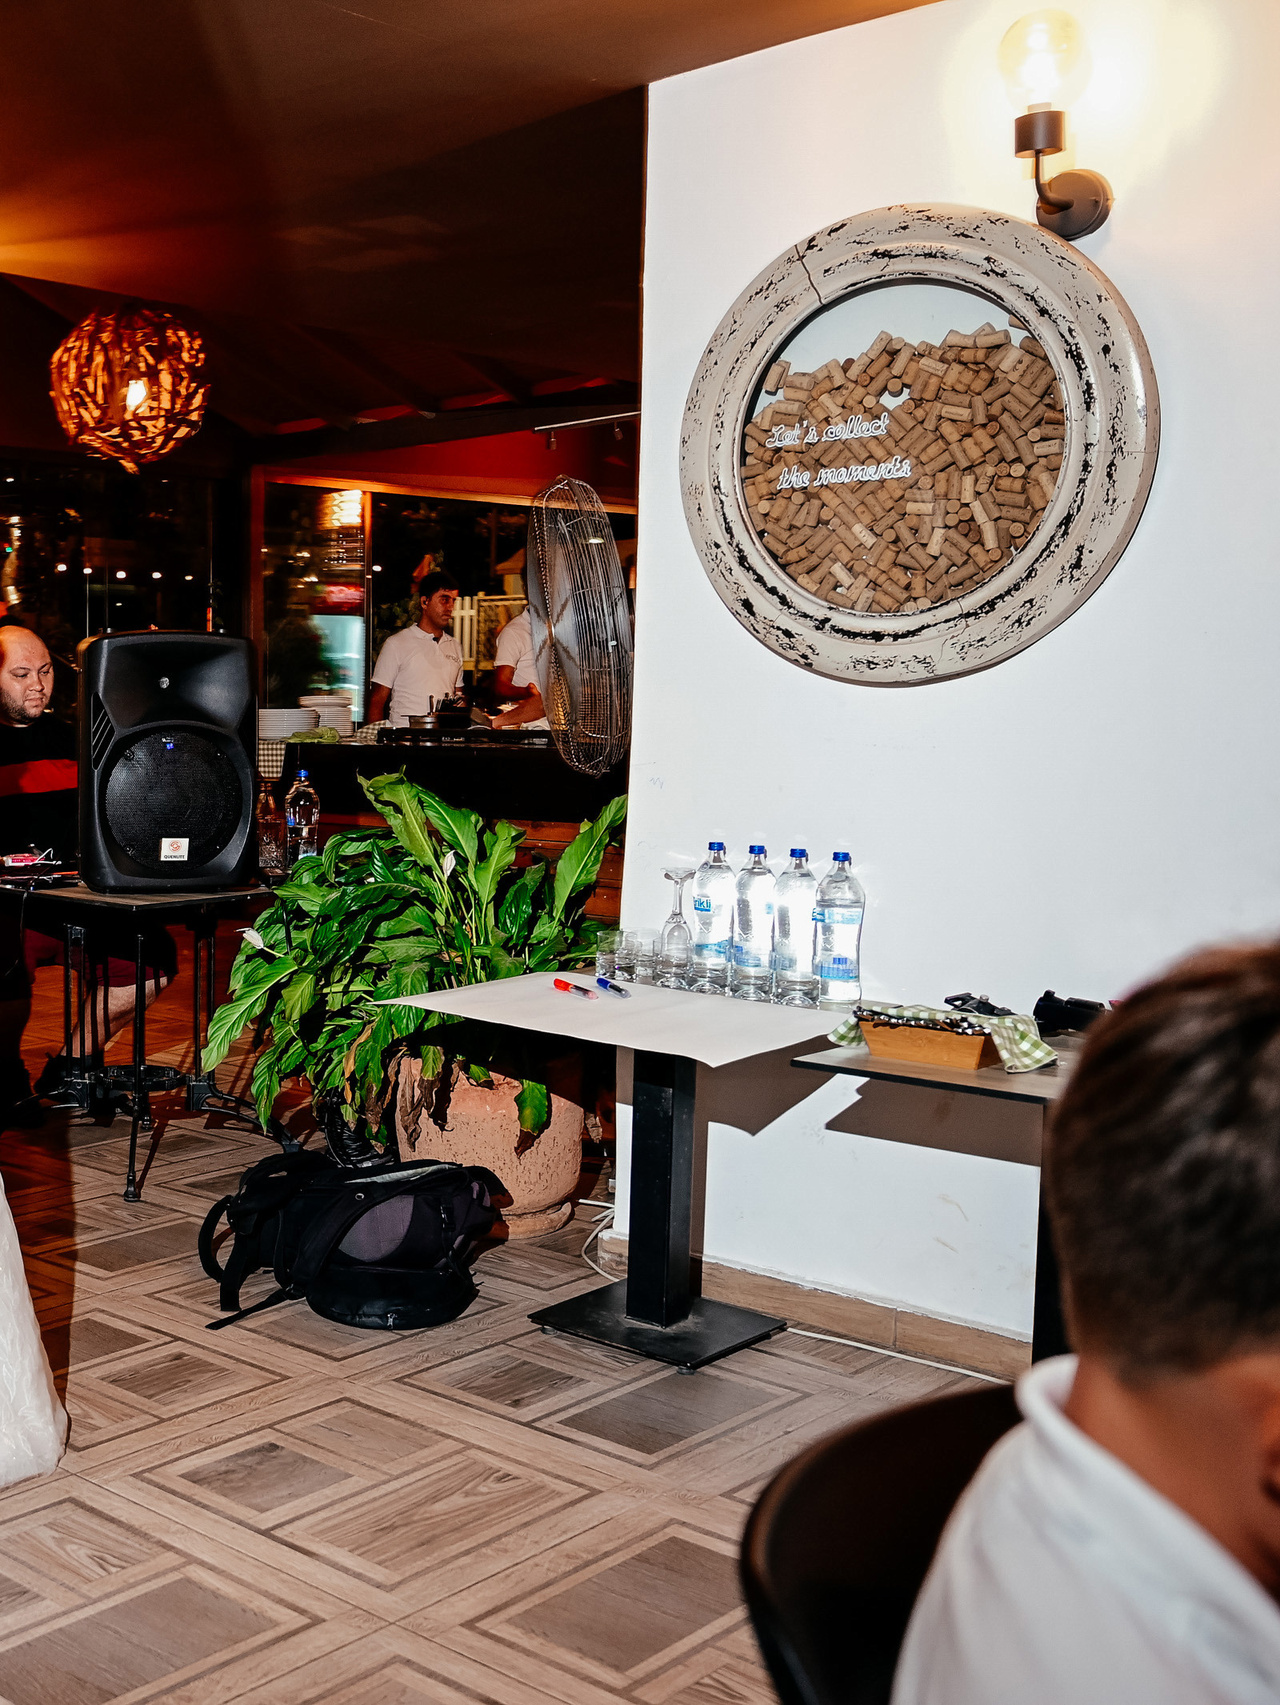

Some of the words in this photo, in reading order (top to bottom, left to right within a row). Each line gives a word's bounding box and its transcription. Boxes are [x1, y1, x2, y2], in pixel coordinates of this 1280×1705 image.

[766, 420, 819, 447] Let's
[822, 412, 889, 441] collect
[777, 465, 810, 490] the
[814, 455, 911, 486] moments
